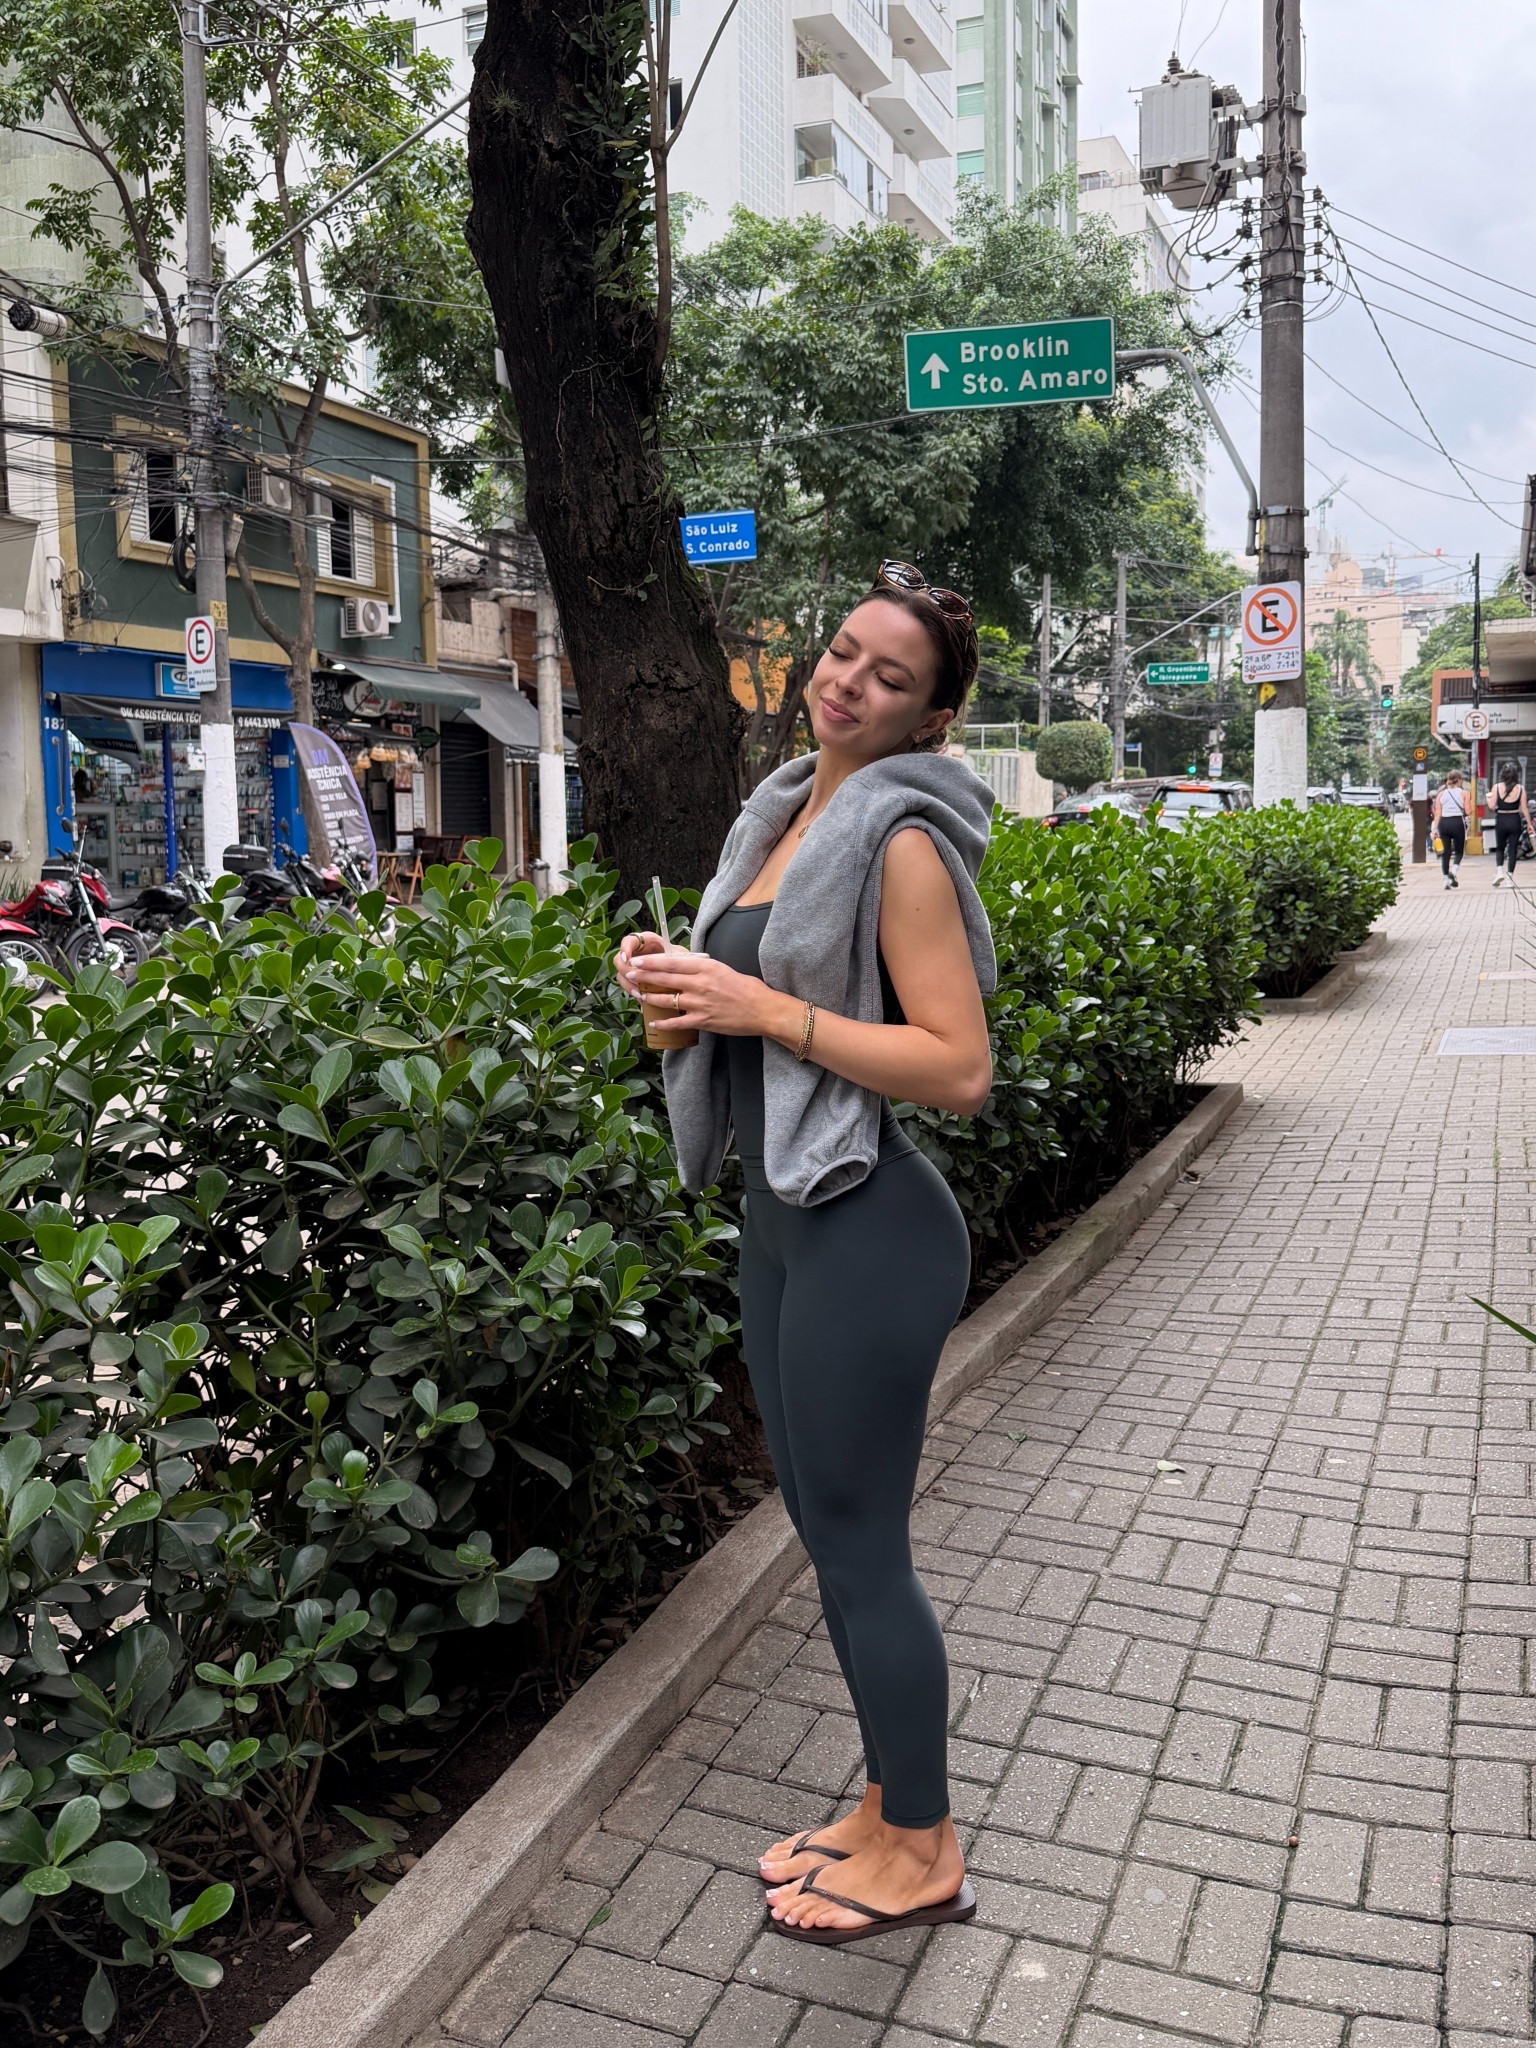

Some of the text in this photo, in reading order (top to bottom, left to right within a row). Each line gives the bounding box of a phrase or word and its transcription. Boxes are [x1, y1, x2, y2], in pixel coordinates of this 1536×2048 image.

[960, 336, 1069, 363] Brooklin
[962, 368, 1108, 395] Sto. Amaro
[685, 522, 738, 537] São Luiz
[686, 539, 750, 555] S. Conrado
[1261, 599, 1279, 634] E
[195, 628, 206, 655] E
